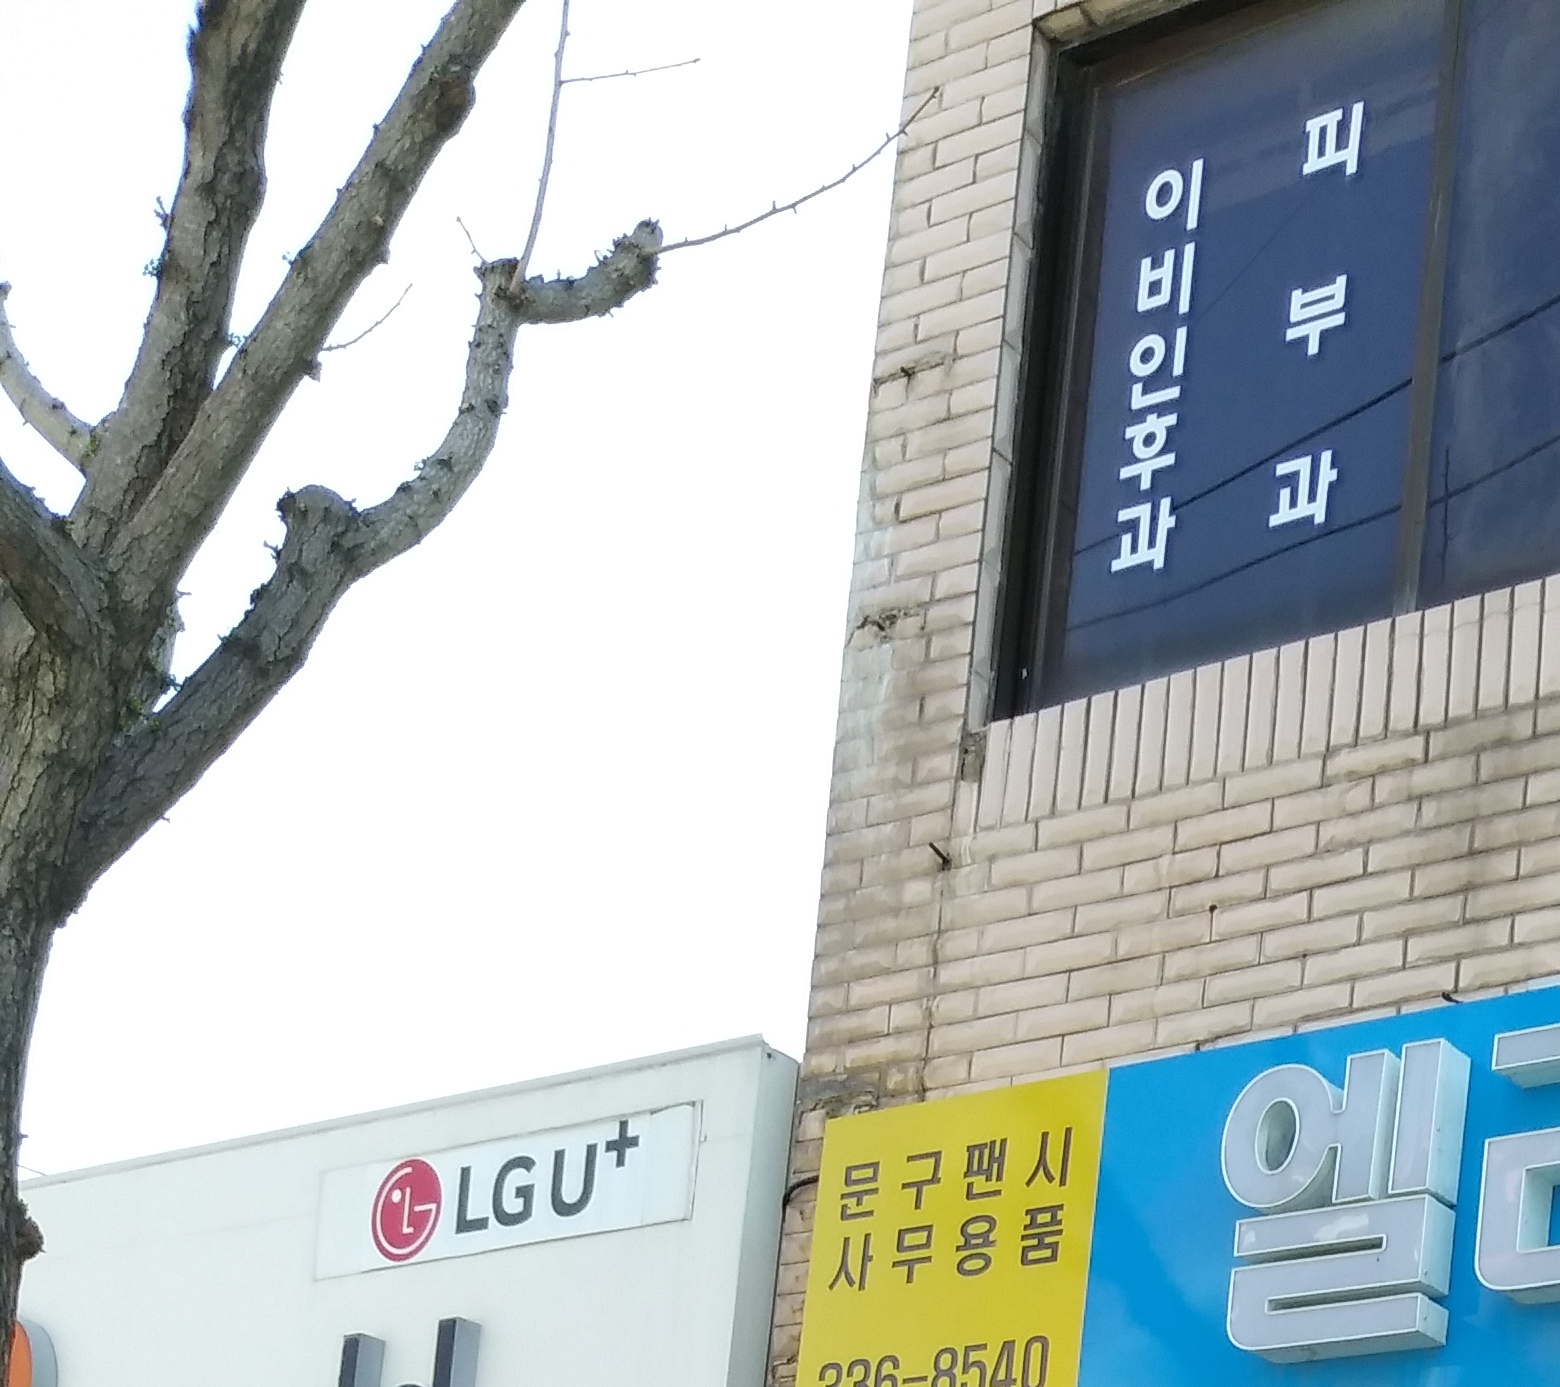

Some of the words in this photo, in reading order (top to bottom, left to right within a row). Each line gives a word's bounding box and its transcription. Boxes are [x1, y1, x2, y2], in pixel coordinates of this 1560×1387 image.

[1110, 158, 1204, 574] 이비인후과
[1268, 101, 1366, 530] 피부과
[827, 1203, 1065, 1293] 사무용품
